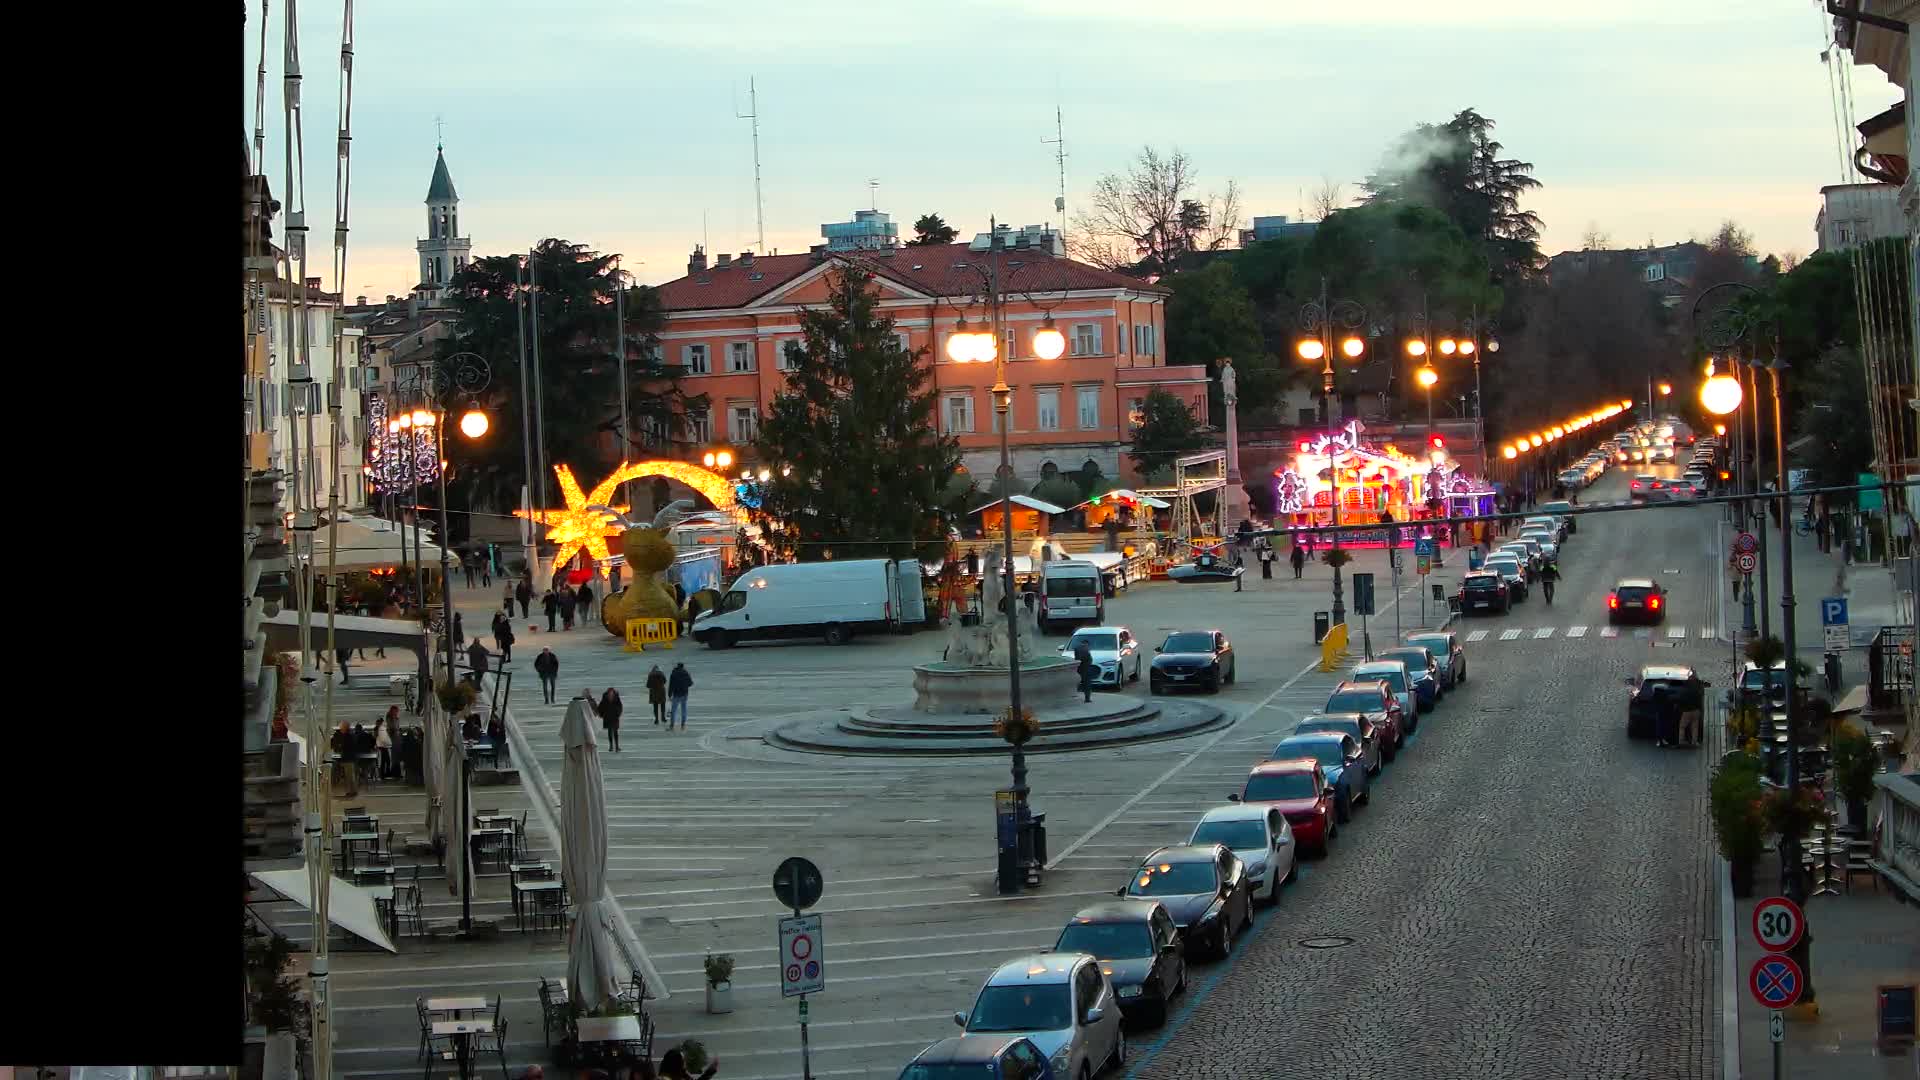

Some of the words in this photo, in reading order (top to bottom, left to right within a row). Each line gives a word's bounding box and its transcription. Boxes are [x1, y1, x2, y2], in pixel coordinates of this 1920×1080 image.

[1743, 557, 1753, 567] 20
[1827, 602, 1842, 621] P
[1762, 911, 1792, 937] 30
